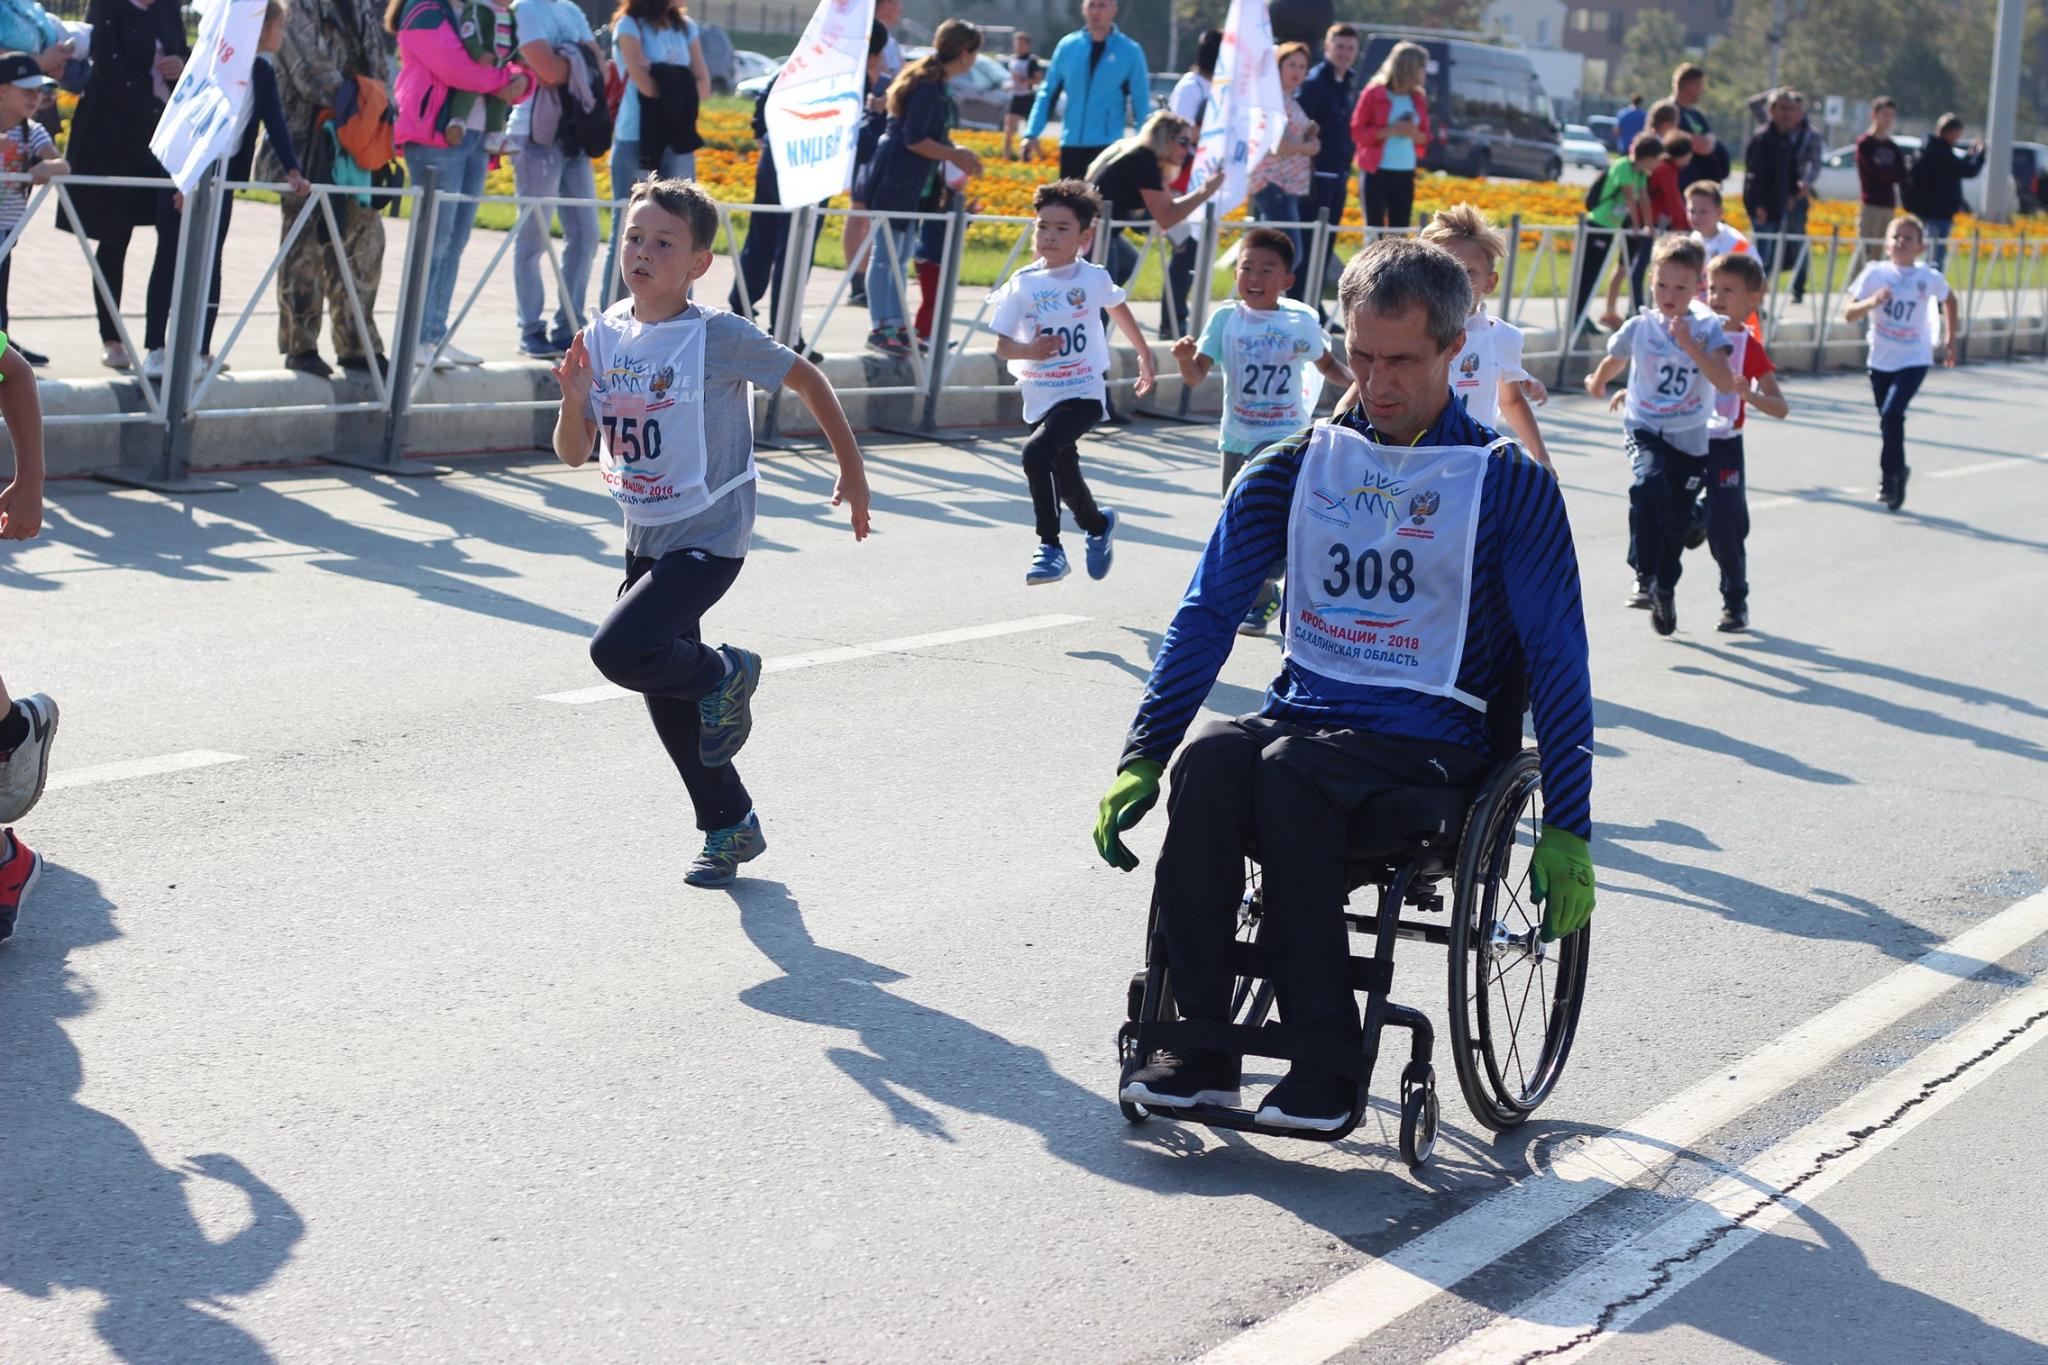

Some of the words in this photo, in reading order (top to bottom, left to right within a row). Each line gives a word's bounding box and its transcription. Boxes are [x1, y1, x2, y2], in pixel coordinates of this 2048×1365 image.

[1883, 299, 1916, 321] 407
[1242, 364, 1292, 396] 272
[1657, 364, 1699, 396] 25
[602, 416, 662, 464] 750
[1323, 543, 1416, 604] 308
[1294, 625, 1361, 659] САХАЛИНСКАЯ
[1363, 648, 1420, 667] ОБЛАСТЬ
[1329, 625, 1377, 645] НАЦИИ
[1387, 634, 1420, 650] 2018
